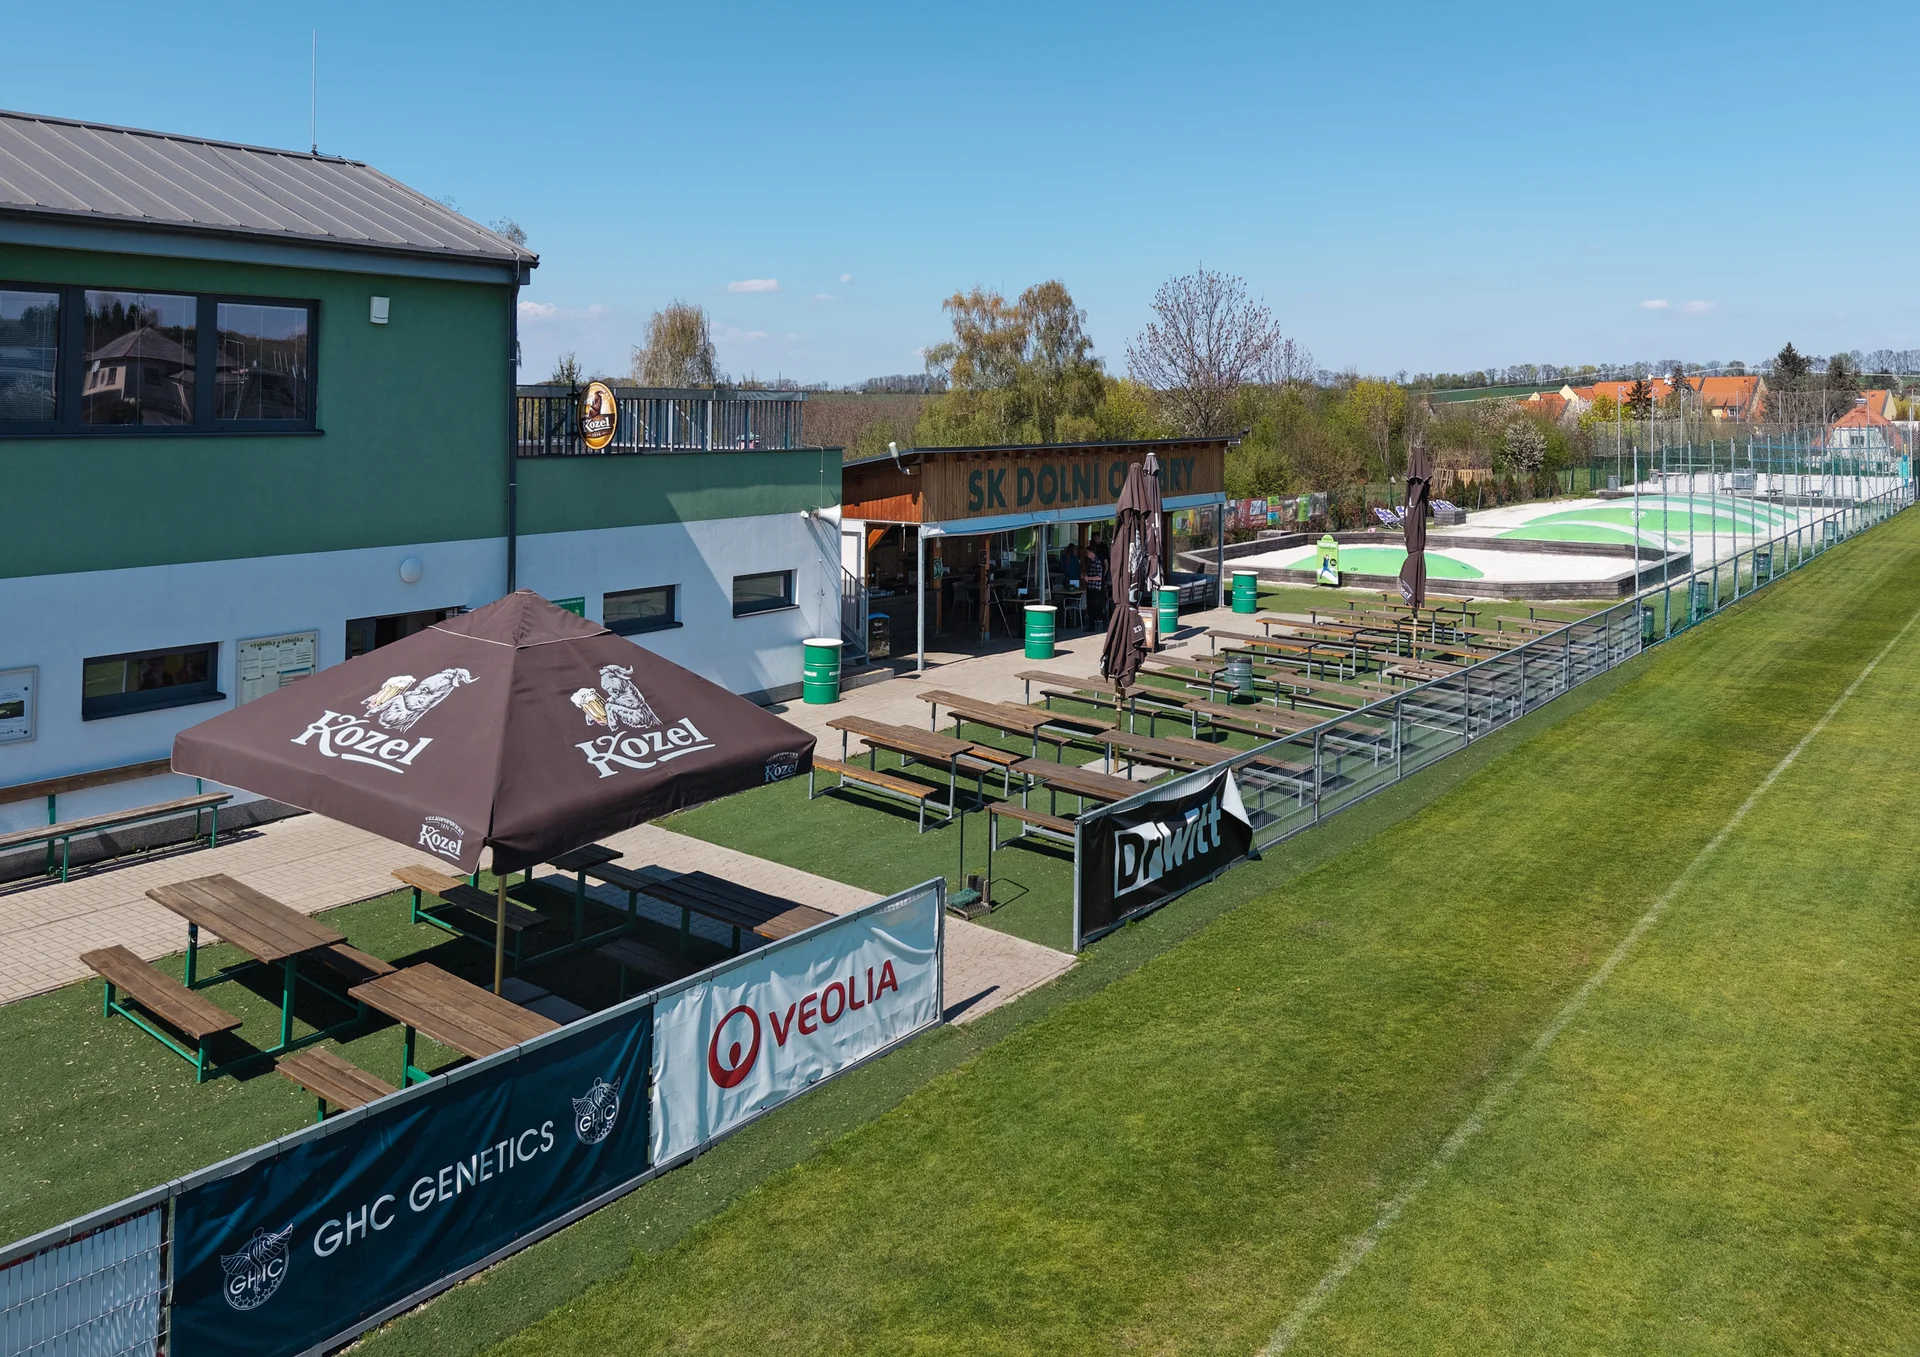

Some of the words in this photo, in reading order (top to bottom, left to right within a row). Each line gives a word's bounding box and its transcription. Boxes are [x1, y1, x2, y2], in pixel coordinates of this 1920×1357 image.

[583, 416, 611, 432] Kozel
[968, 468, 1008, 512] SK
[1017, 457, 1101, 507] DOLNÍ
[1108, 456, 1197, 499] CBRY
[250, 640, 276, 648] výsledky
[290, 710, 434, 767] Kozel
[575, 717, 712, 779] Kozel
[765, 760, 798, 782] Kozel
[418, 824, 463, 857] Kozel
[769, 959, 899, 1047] VEOLIA
[579, 1104, 616, 1132] GHC
[313, 1194, 396, 1258] GHC
[409, 1120, 555, 1213] GENETICS
[229, 1257, 283, 1295] GHC
